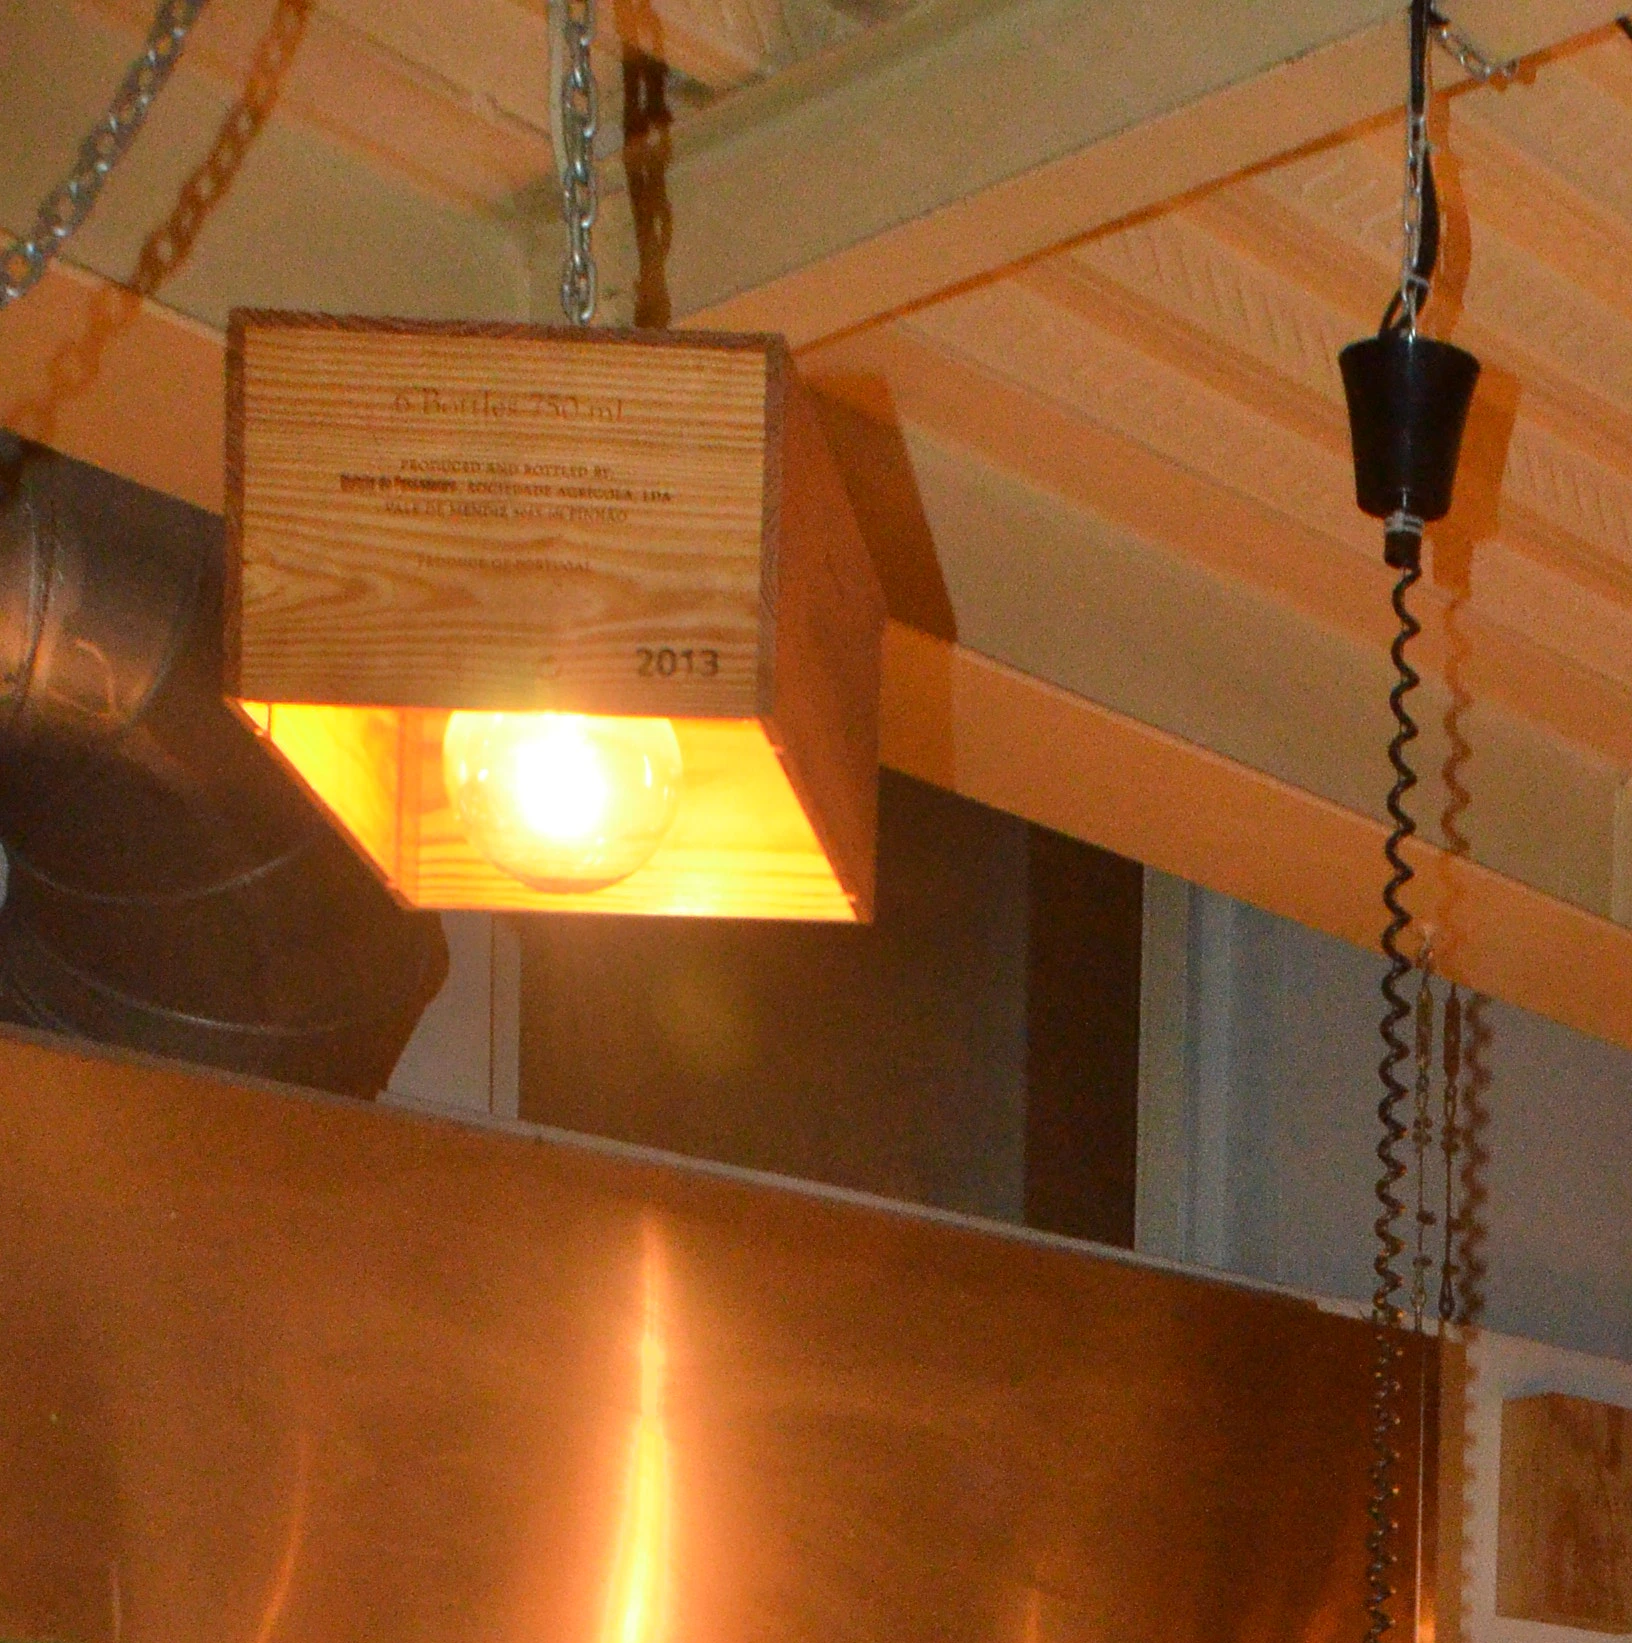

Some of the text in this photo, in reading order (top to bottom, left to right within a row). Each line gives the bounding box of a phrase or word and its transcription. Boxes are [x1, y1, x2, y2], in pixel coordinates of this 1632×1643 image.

[419, 386, 521, 418] Bottles
[401, 458, 481, 475] PRODUCED
[486, 461, 519, 476] AND
[524, 463, 588, 478] BOTTLED
[636, 646, 719, 678] 2013
